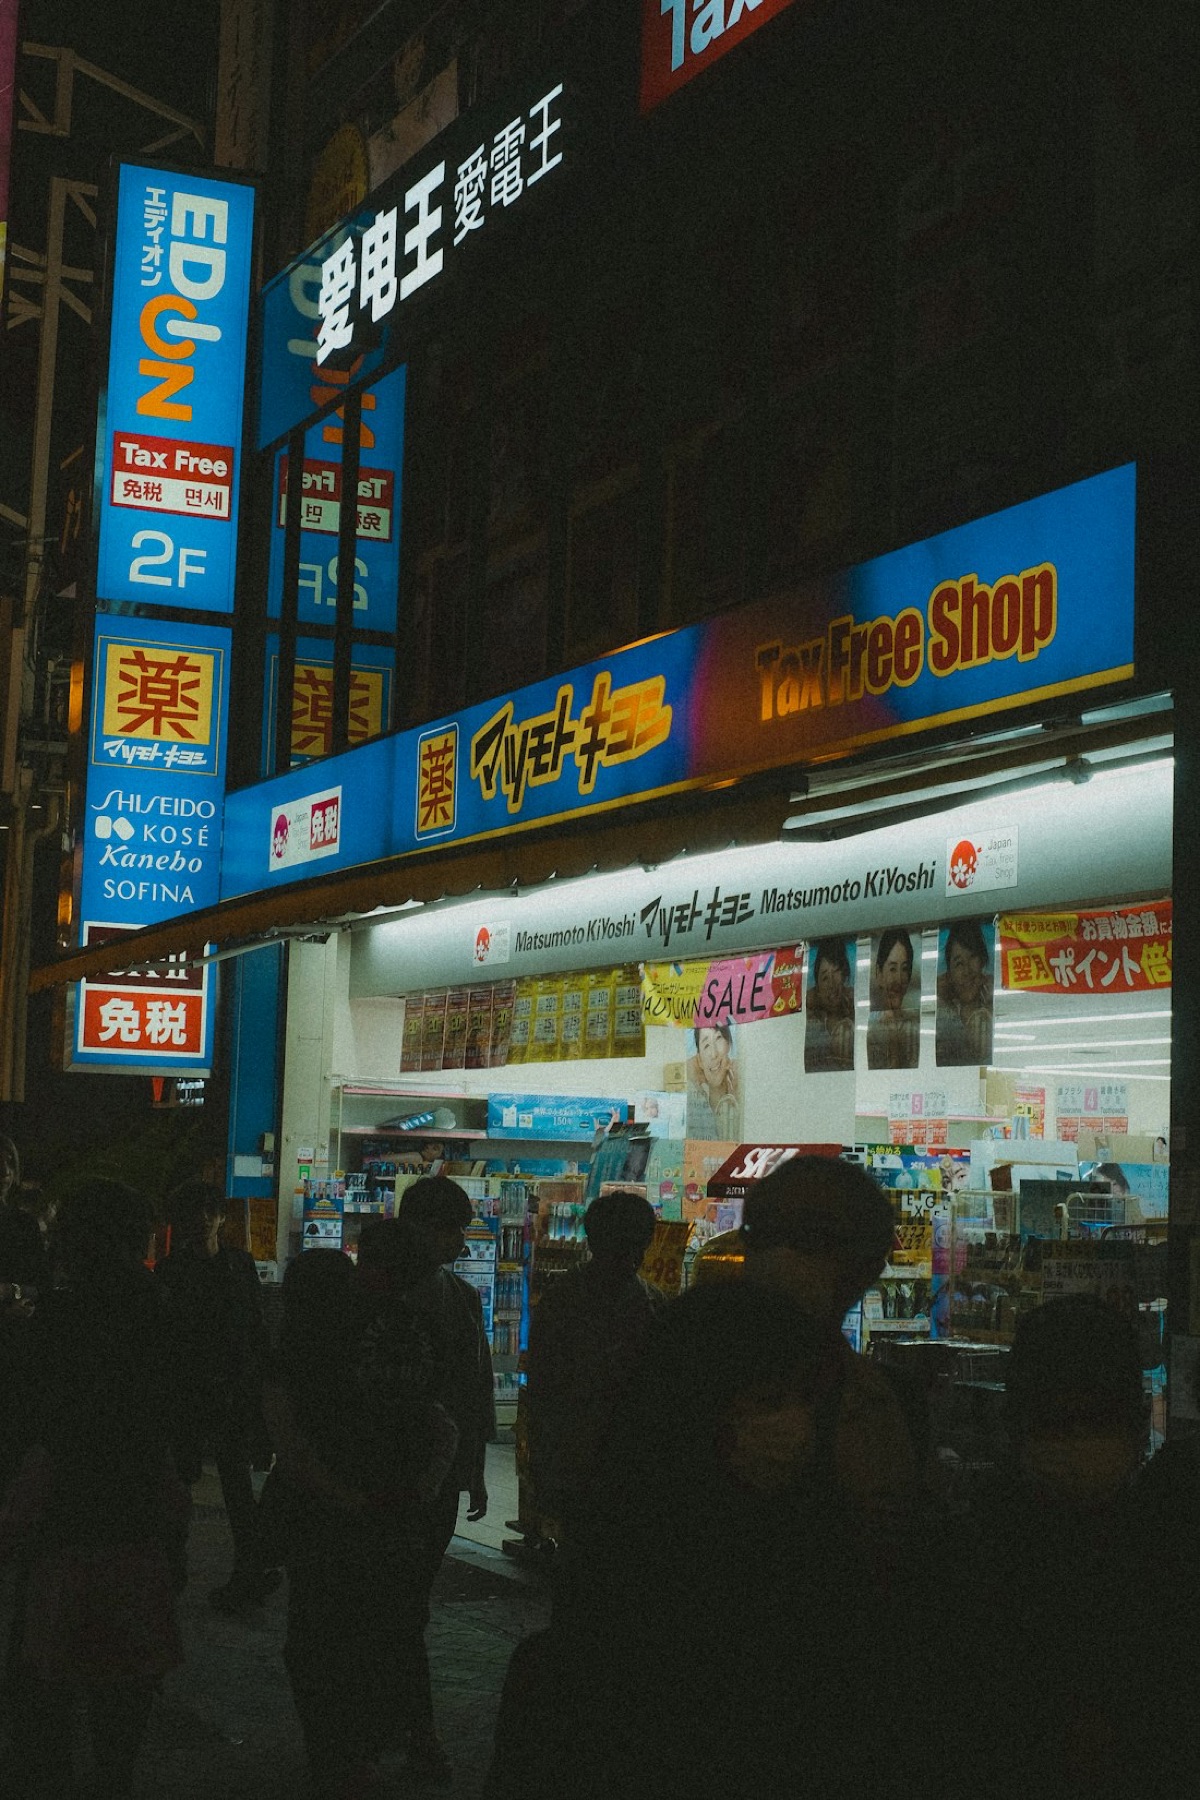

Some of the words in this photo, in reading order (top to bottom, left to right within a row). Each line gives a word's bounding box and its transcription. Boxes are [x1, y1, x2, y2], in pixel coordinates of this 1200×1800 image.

[141, 187, 167, 287] エディオン
[317, 161, 444, 366] 爱电王
[454, 83, 563, 246] 愛電王
[120, 442, 167, 469] Tax
[174, 450, 228, 478] Free
[122, 478, 162, 503] 免税
[185, 487, 223, 511] 면세
[128, 529, 207, 589] 2F
[757, 641, 825, 722] Tax
[829, 615, 921, 702] Free
[929, 562, 1058, 677] Shop
[117, 650, 201, 740] 薬
[102, 740, 208, 767] マツモトキヨシ
[472, 674, 672, 813] マツモトキヨシ
[91, 789, 216, 819] SHISEIDO
[421, 738, 455, 824] 薬
[99, 844, 203, 874] Kanebo
[143, 823, 209, 848] KOSÉ
[987, 838, 1012, 851] Japan
[103, 878, 195, 904] SOFINA
[760, 877, 861, 915] Matsumoto
[864, 861, 936, 898] KiYoshi
[515, 923, 585, 952] Matsumoto
[587, 913, 636, 942] KiYoshi
[640, 886, 755, 947] マツモトキヨシ
[645, 995, 701, 1020] AUTUMN
[704, 971, 767, 1018] SALE
[98, 997, 188, 1046] 免税
